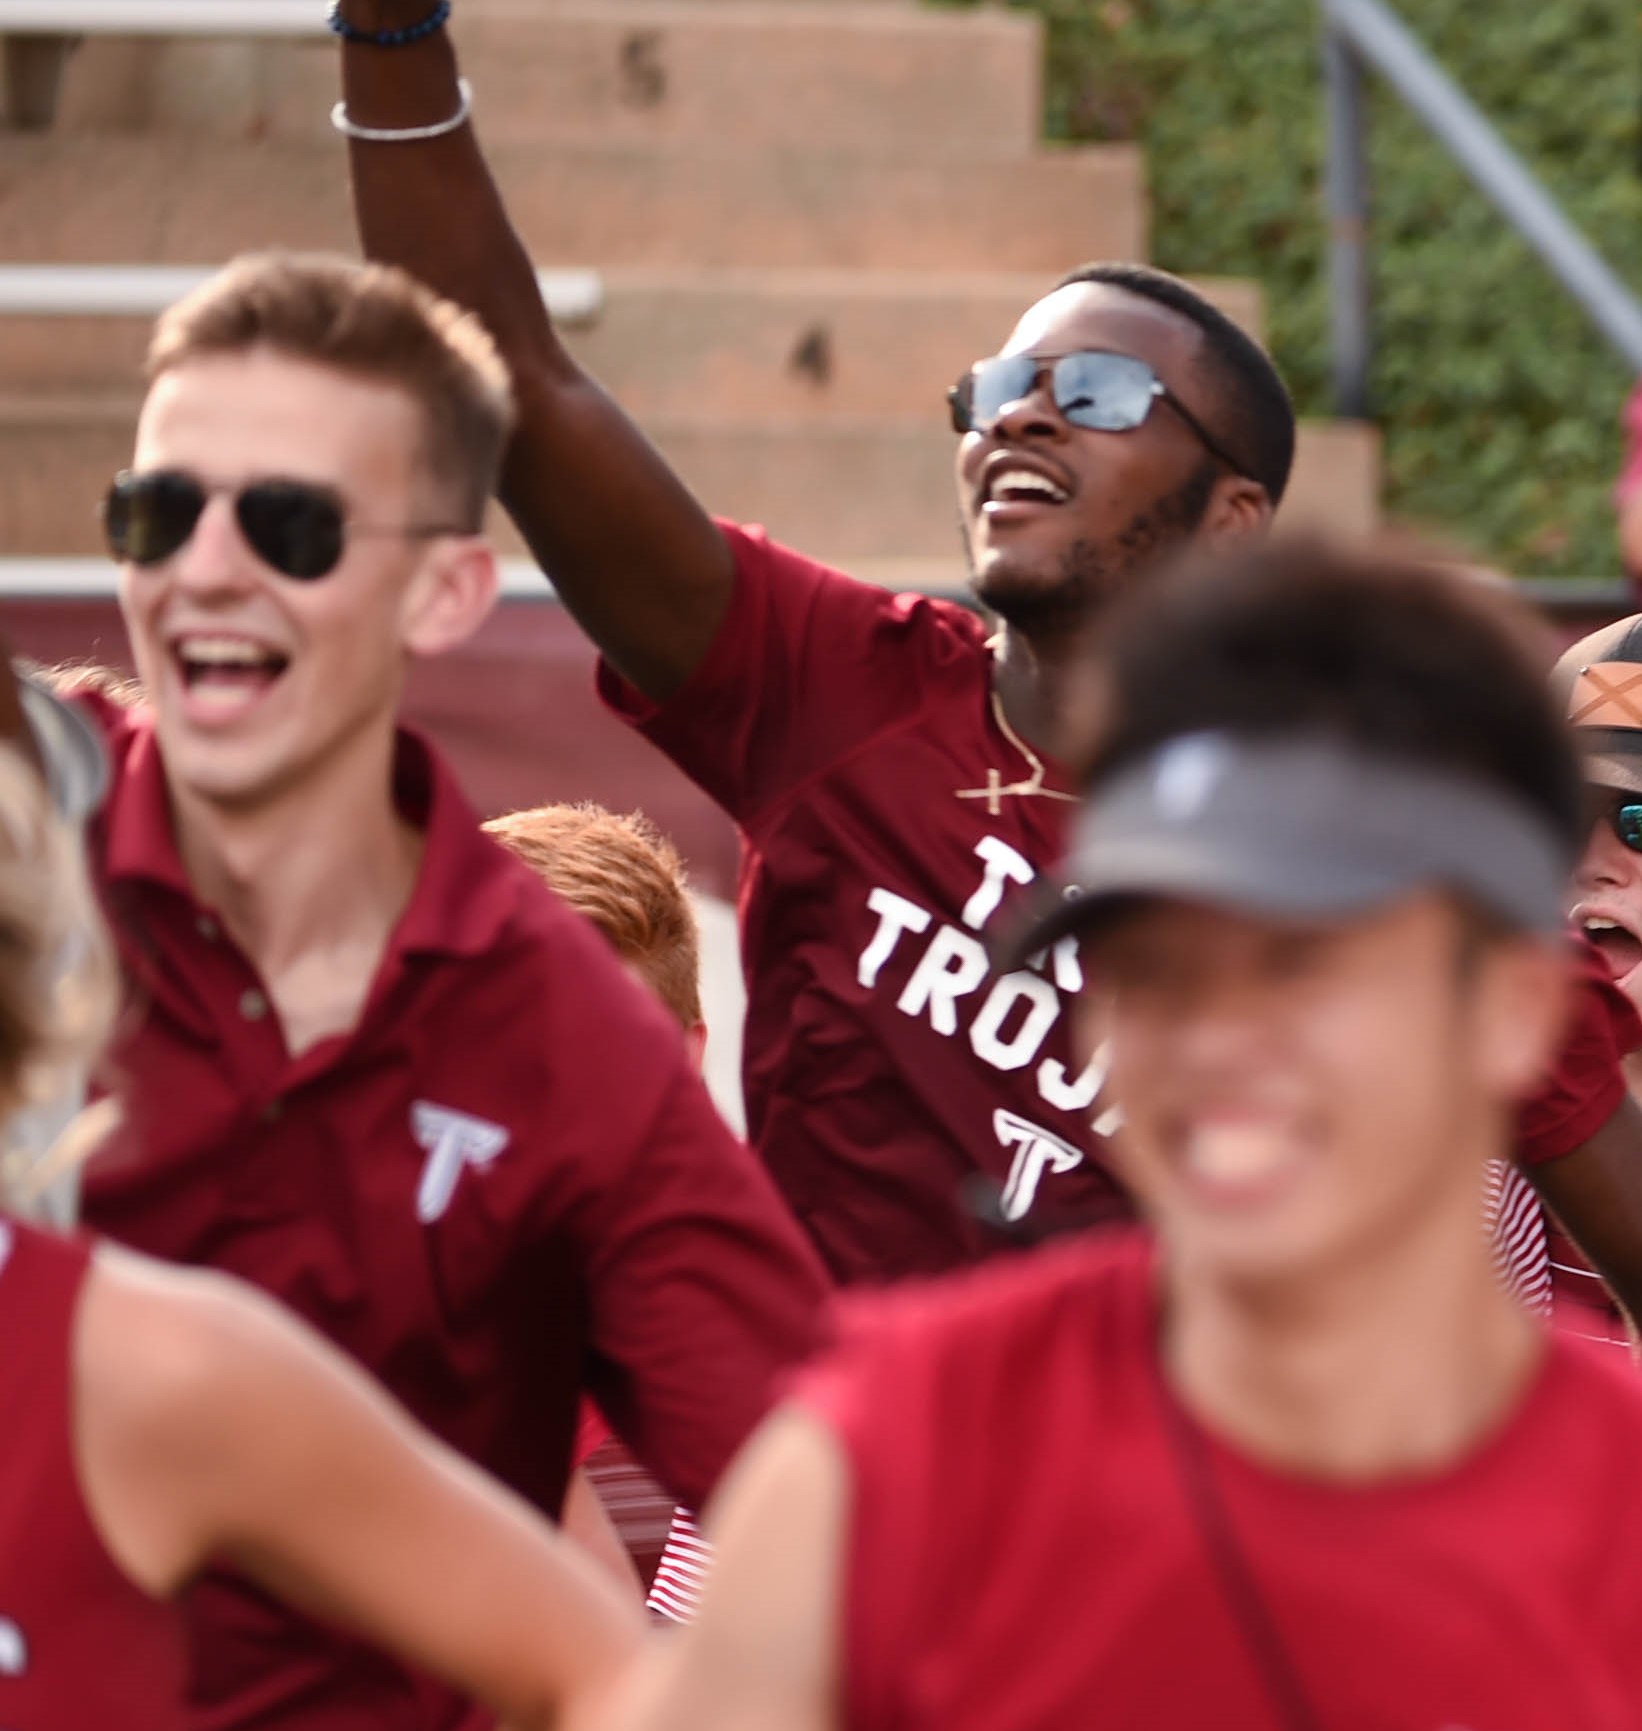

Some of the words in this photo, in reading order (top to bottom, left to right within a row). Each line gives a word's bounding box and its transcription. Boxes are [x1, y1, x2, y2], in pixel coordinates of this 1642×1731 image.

[856, 887, 1126, 1138] TROJ
[408, 1099, 511, 1225] T
[992, 1107, 1085, 1223] T
